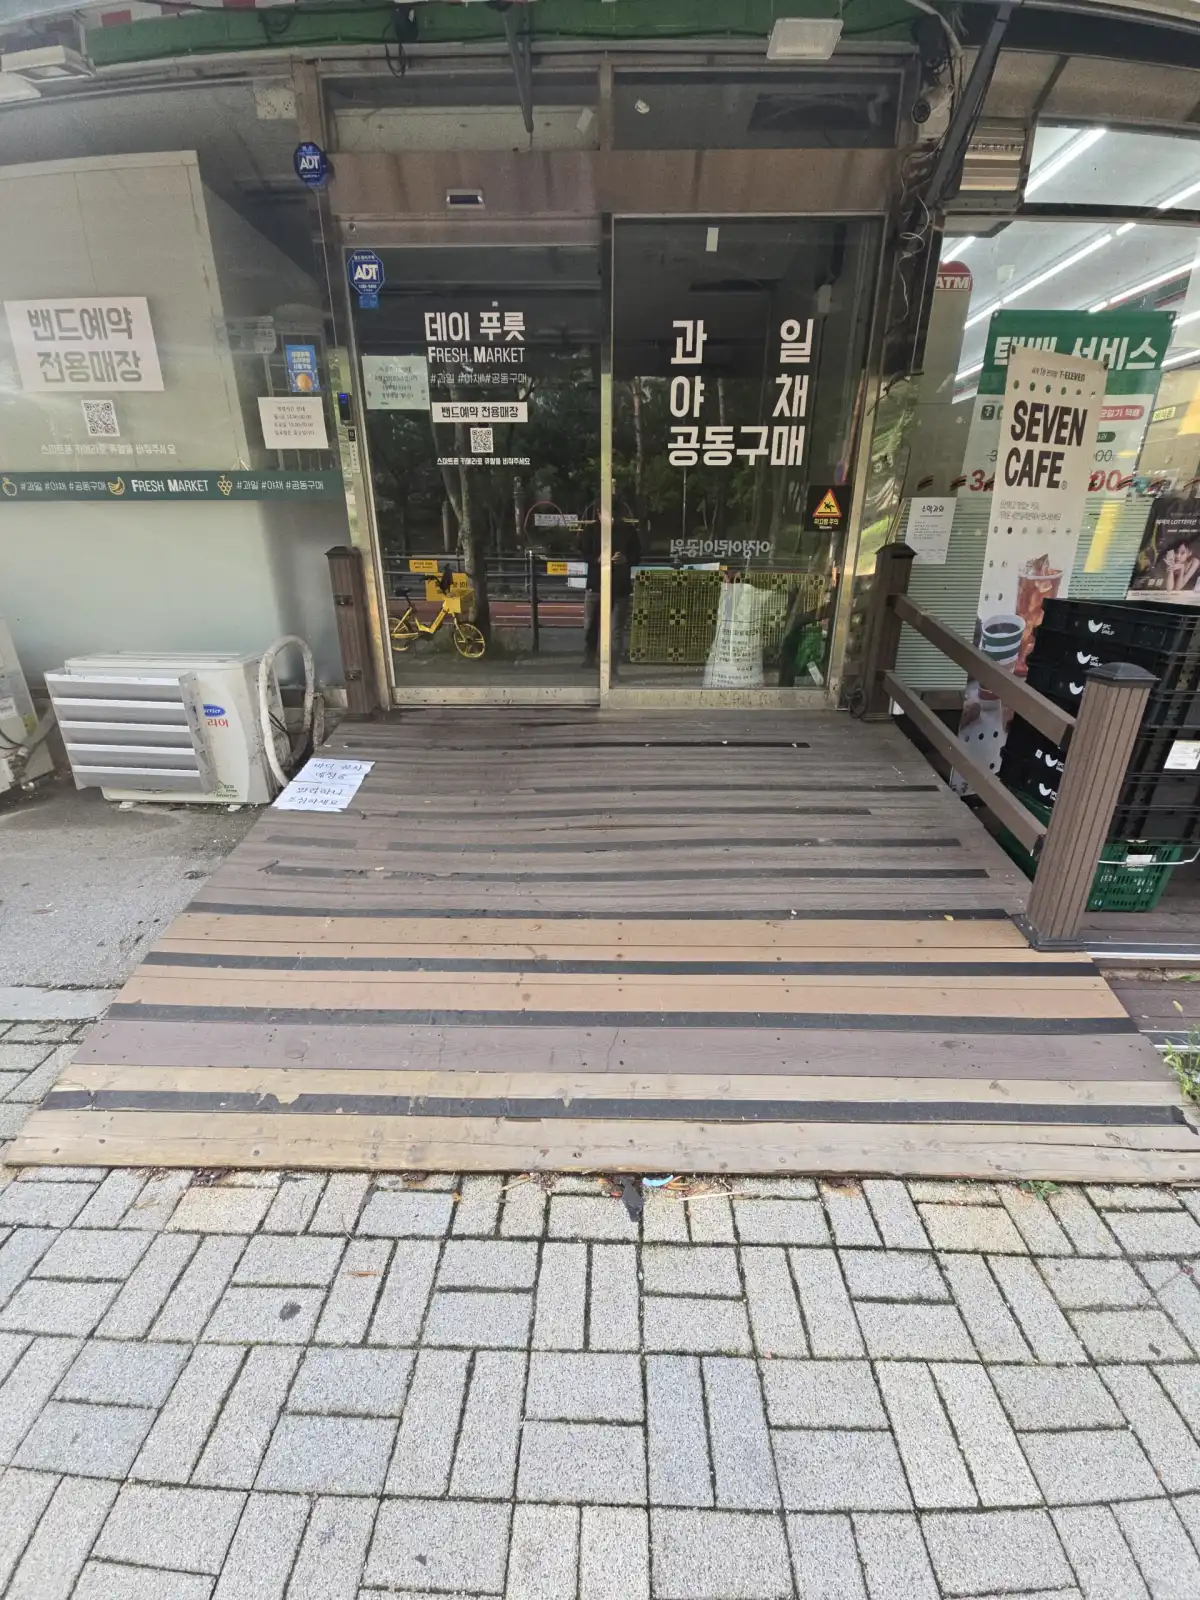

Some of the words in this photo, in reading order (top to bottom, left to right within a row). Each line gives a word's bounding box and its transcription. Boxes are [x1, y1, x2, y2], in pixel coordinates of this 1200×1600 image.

[300, 156, 320, 170] ADT
[354, 264, 379, 280] ADT
[936, 276, 970, 289] ATM
[27, 307, 133, 341] 밴드예약
[424, 312, 471, 341] 데이
[479, 312, 526, 341] 푸릇
[428, 346, 468, 363] FRESH
[474, 346, 526, 363] MARKET
[1071, 337, 1158, 371] 서비스
[37, 350, 142, 383] 전용매장
[430, 373, 454, 384] #과일
[485, 373, 526, 384] #공동구매
[442, 406, 478, 418] 밴드예약
[482, 406, 518, 418] 전용매장
[1010, 400, 1088, 446] SEVEN
[40, 444, 73, 454] 스마트폰
[668, 426, 806, 466] 공동구매
[1004, 447, 1065, 489] CAFE
[20, 481, 43, 492] #과일
[69, 481, 106, 492] #공동구매
[131, 480, 164, 492] FRESH
[168, 480, 208, 492] MARKET
[236, 480, 258, 490] #과일
[262, 480, 284, 490] #야채
[286, 480, 324, 490] #공동구매
[207, 718, 229, 728] 리어
[288, 796, 338, 805] 조심하세요
